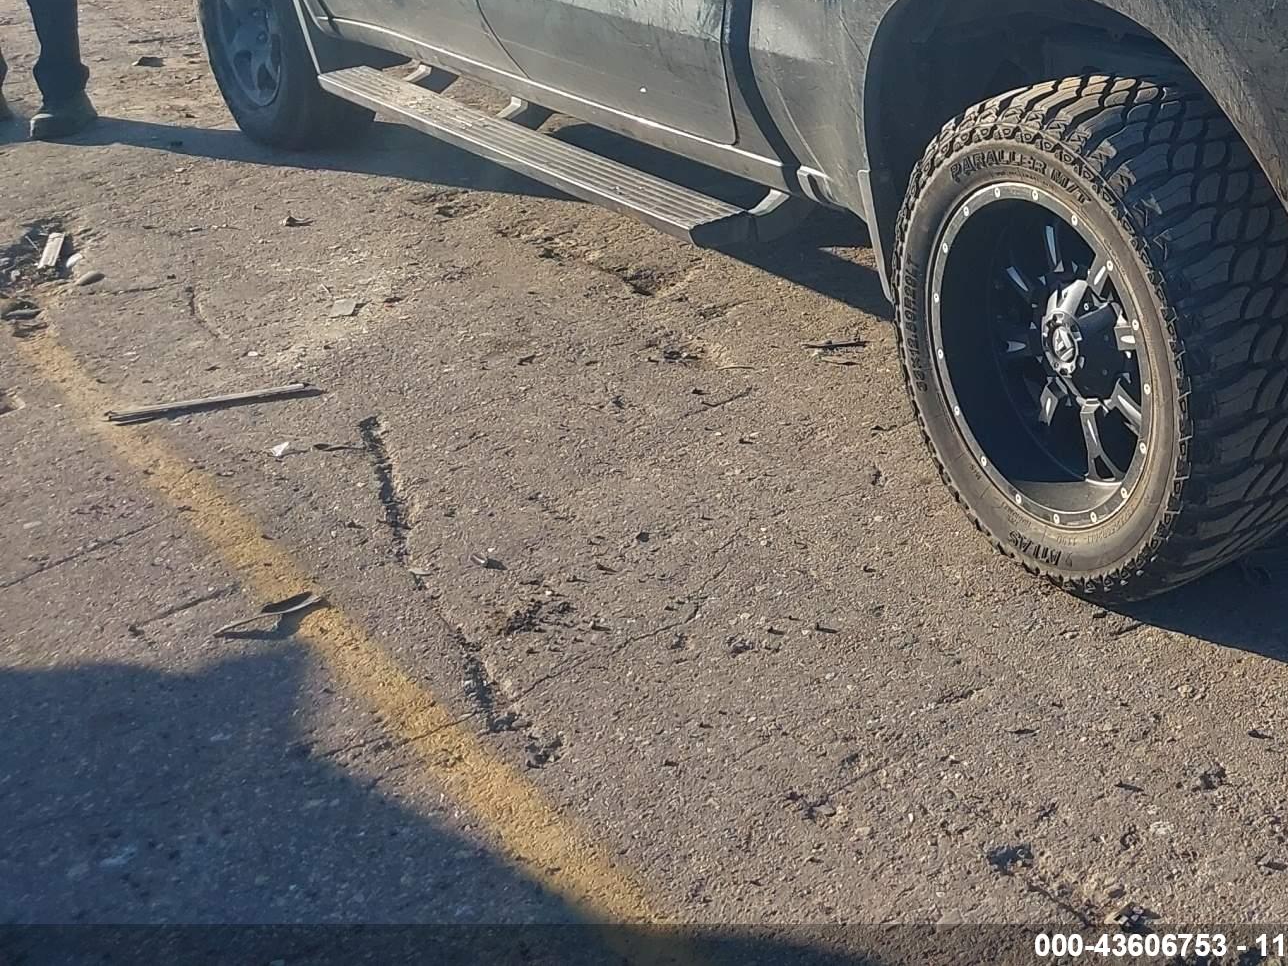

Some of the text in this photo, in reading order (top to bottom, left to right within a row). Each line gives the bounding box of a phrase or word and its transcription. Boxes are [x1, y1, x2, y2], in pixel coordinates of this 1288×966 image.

[950, 149, 1048, 183] PARALLER
[1050, 168, 1092, 204] M/T
[1007, 530, 1062, 566] ATLAS
